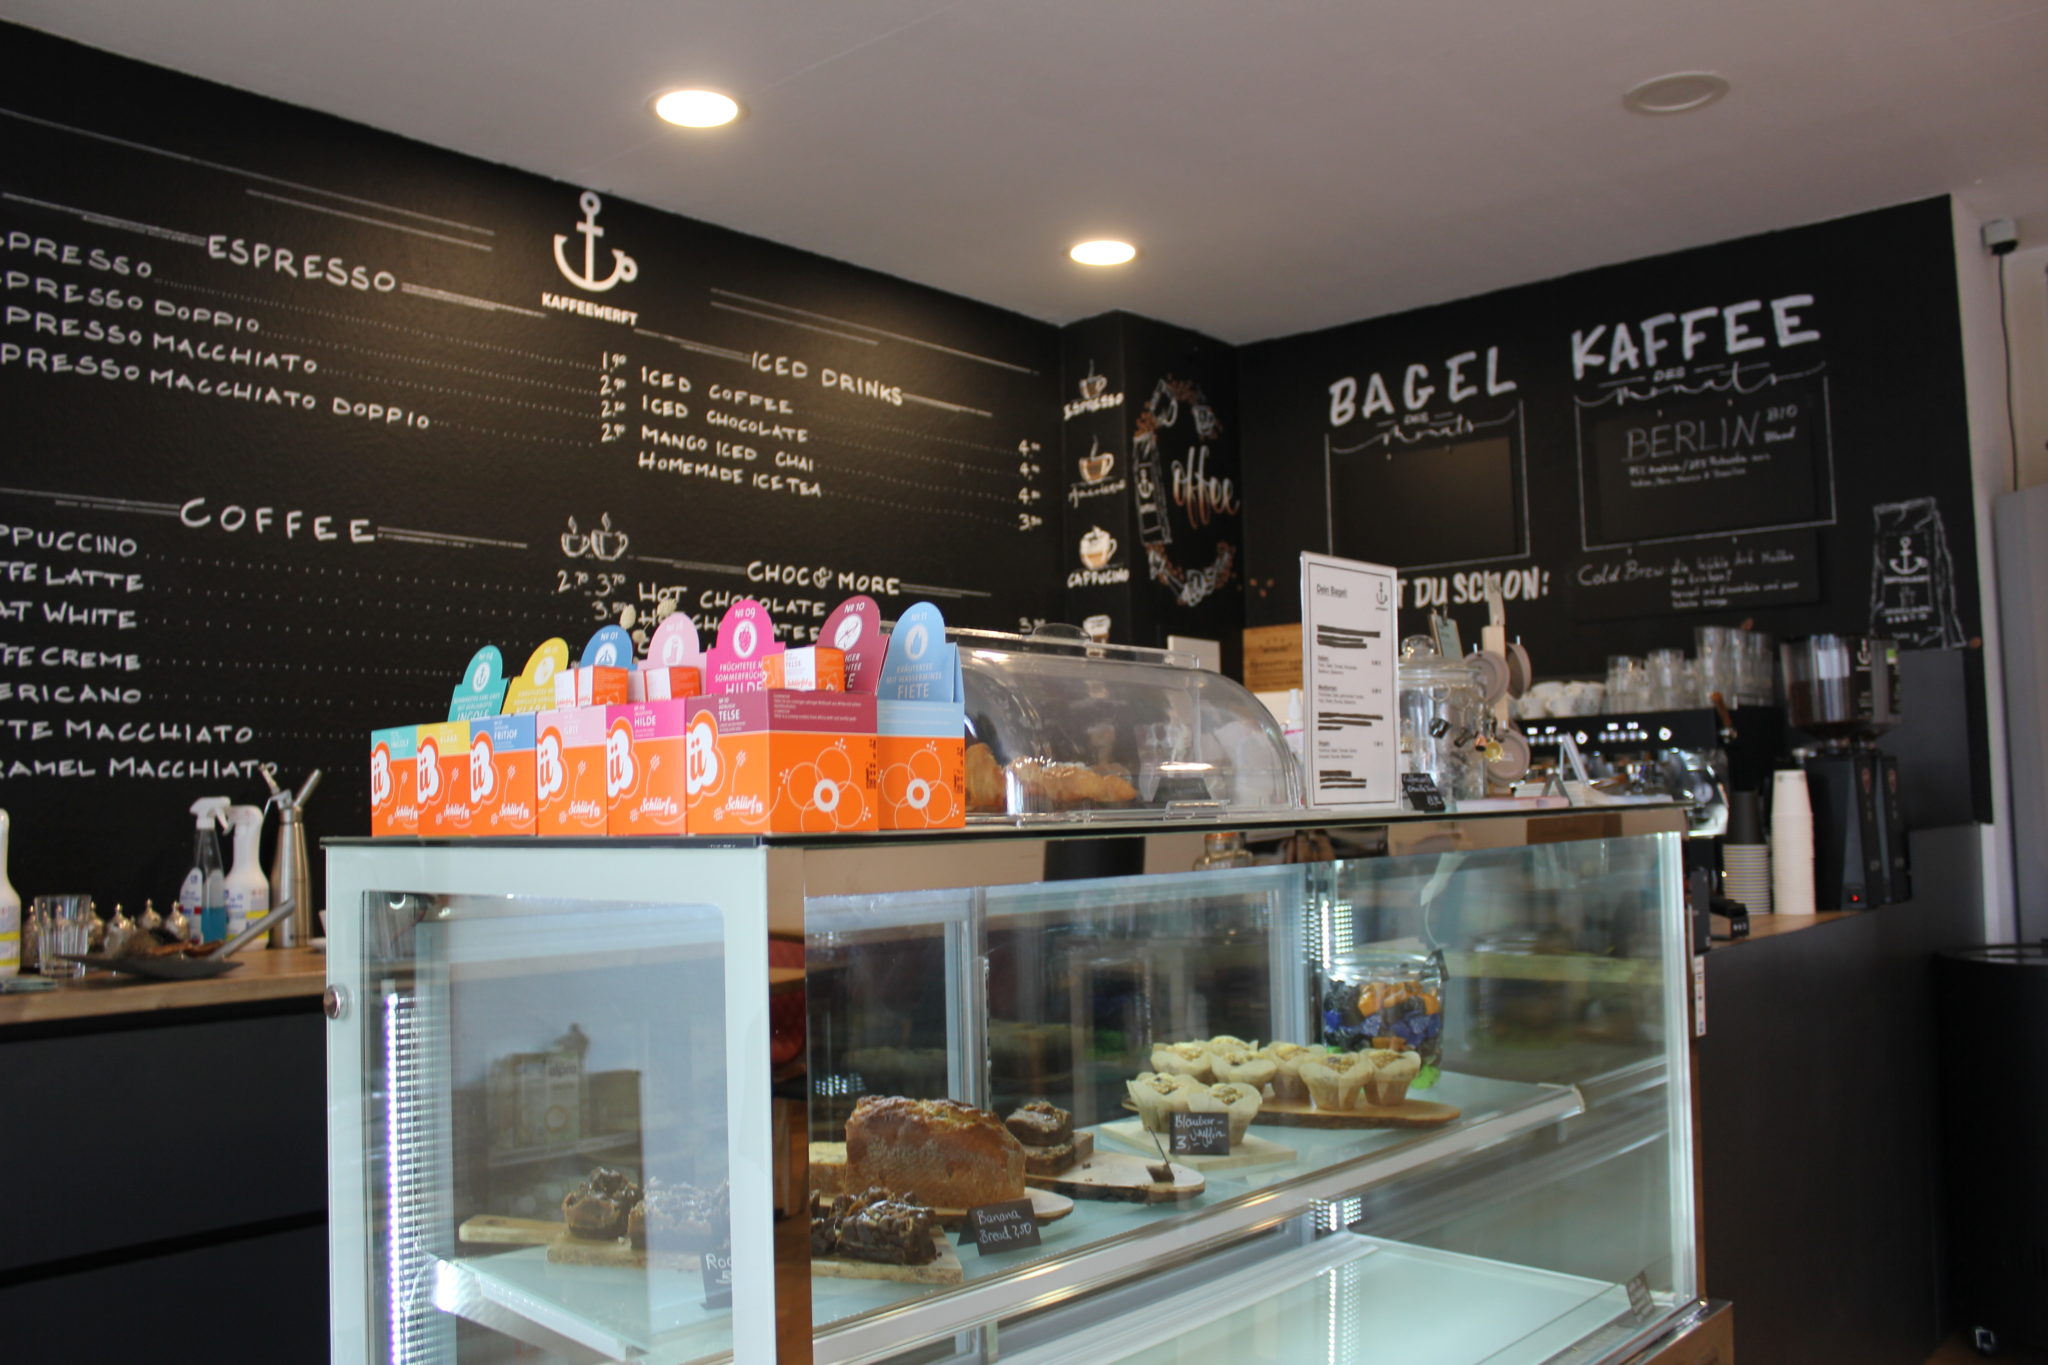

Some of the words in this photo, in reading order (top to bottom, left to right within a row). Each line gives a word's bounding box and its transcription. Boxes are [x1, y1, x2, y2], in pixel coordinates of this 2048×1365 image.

[0, 231, 152, 278] PRESSO
[208, 235, 396, 292] ESPRESSO
[0, 271, 144, 310] PRESSO
[155, 299, 260, 332] DOPPIO
[541, 292, 639, 327] KAFFEEWERFT
[6, 306, 143, 346] PRESSO
[153, 332, 317, 373] MACCHIATO
[1572, 294, 1821, 381] KAFFEE
[1, 343, 140, 380] PRESSO
[150, 368, 316, 409] MACCHIATO
[332, 397, 430, 429] DOPPIO
[641, 366, 692, 393] ICED
[709, 384, 793, 414] COFFEE
[752, 351, 808, 379] ICED
[821, 368, 903, 406] DRINKS
[1329, 346, 1517, 427] BAGEL
[642, 395, 688, 418] ICED
[706, 410, 808, 443] CHOCOLATE
[1624, 411, 1760, 463] BERLIN
[641, 425, 708, 452] MANGO
[716, 441, 757, 461] ICED
[775, 451, 814, 473] CHAI
[638, 451, 743, 485] HOMEMADE
[752, 473, 783, 491] ICE
[786, 477, 822, 498] TEA
[179, 498, 376, 544] COFFEE
[46, 566, 144, 592] LATTE
[747, 560, 810, 587] CHOC
[838, 572, 900, 596] MORE
[1578, 563, 1619, 586] Cold
[638, 582, 688, 602] HOT
[700, 591, 826, 617] CHOLATE
[1413, 577, 1448, 609] DU
[43, 602, 137, 629] WHITE
[41, 646, 141, 671] CREME
[897, 682, 929, 698] FIETE
[0, 719, 53, 740] TE
[65, 719, 252, 743] MACCHIATO
[634, 715, 656, 727] HILDE
[719, 709, 740, 722] TELSE
[0, 760, 96, 778] AMEL
[109, 757, 278, 779] MACCHIATO
[976, 1209, 1022, 1226] Banana
[979, 1224, 1012, 1244] Bread
